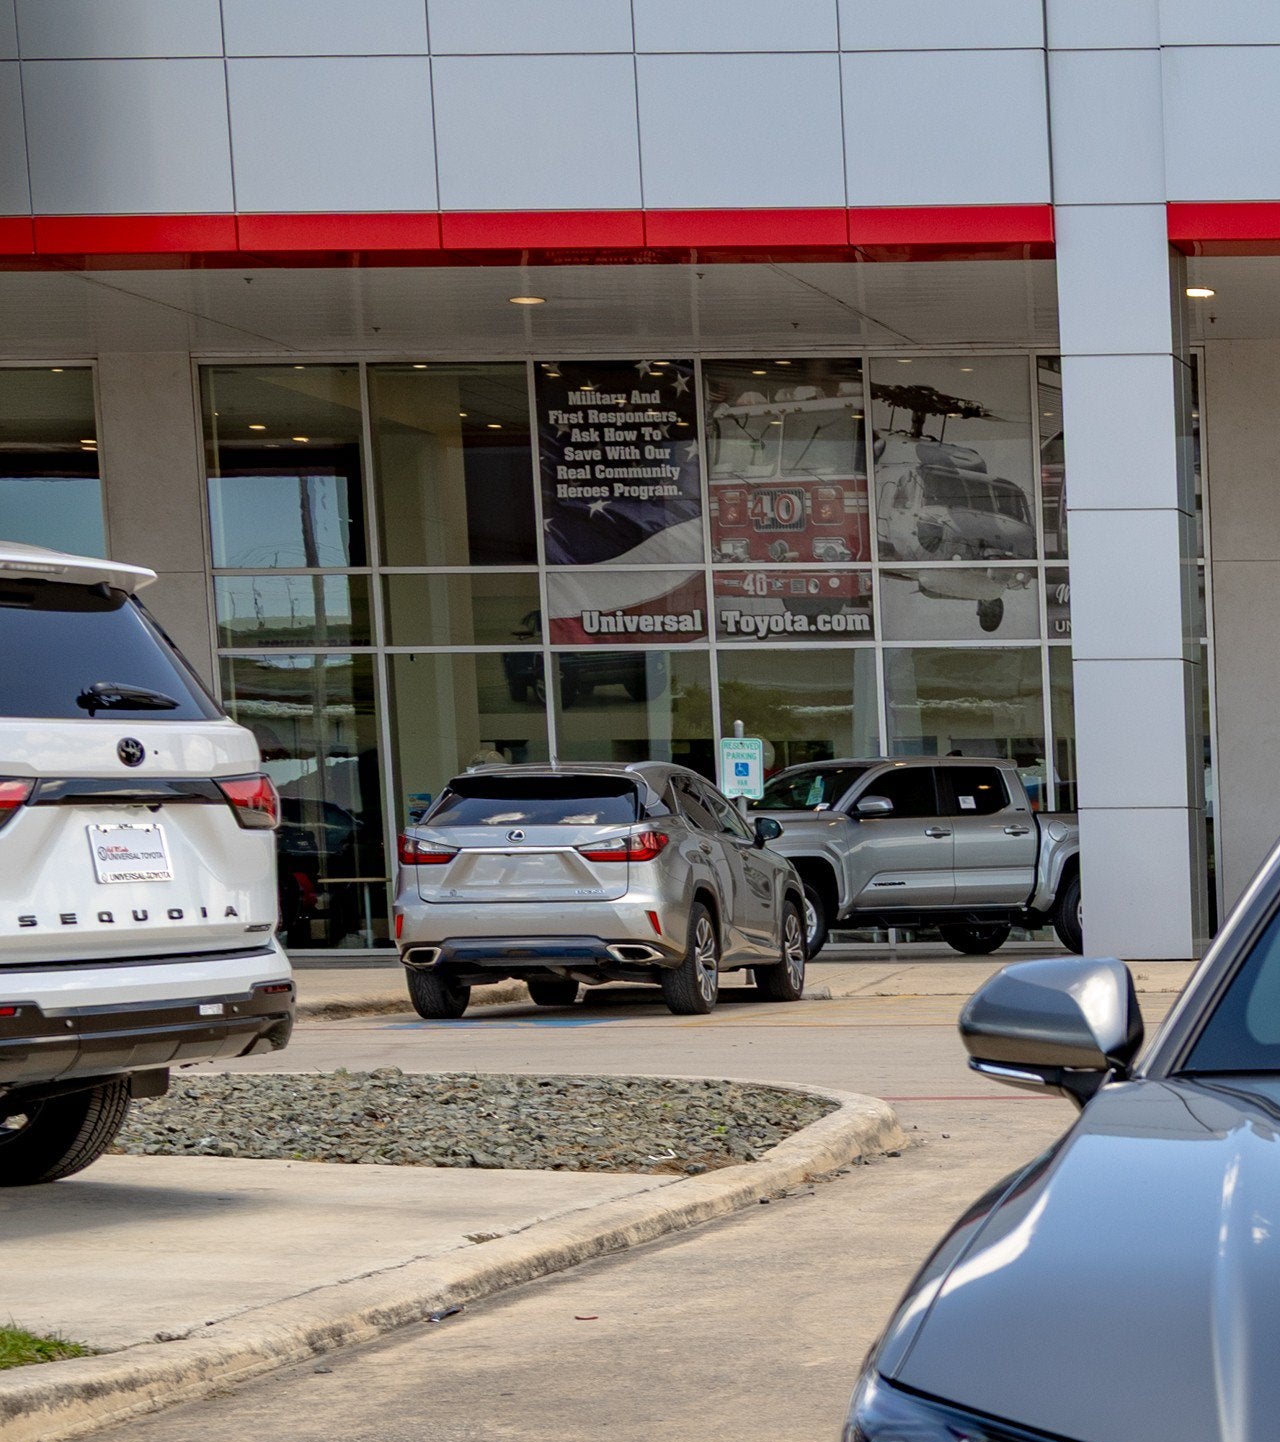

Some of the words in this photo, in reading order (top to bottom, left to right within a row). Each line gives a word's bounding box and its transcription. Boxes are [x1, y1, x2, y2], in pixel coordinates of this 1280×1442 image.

[568, 391, 626, 407] Military
[631, 390, 660, 404] And
[548, 410, 583, 424] First
[587, 408, 681, 426] Responders,
[571, 428, 600, 442] Ask
[604, 428, 637, 441] How
[641, 427, 662, 440] To
[564, 446, 602, 461] Save
[605, 446, 640, 460] With
[644, 445, 671, 459] Our
[556, 465, 591, 479] Real
[594, 464, 680, 480] Community
[556, 484, 609, 498] Heroes
[613, 483, 682, 499] Program.
[750, 494, 800, 526] 40
[743, 573, 767, 595] 40
[582, 610, 702, 634] Universal
[721, 610, 870, 638] Toyota.com
[107, 852, 141, 860] UNIVERSAL
[109, 873, 145, 881] UNIVERSAL
[18, 905, 239, 928] SEQUOIA
